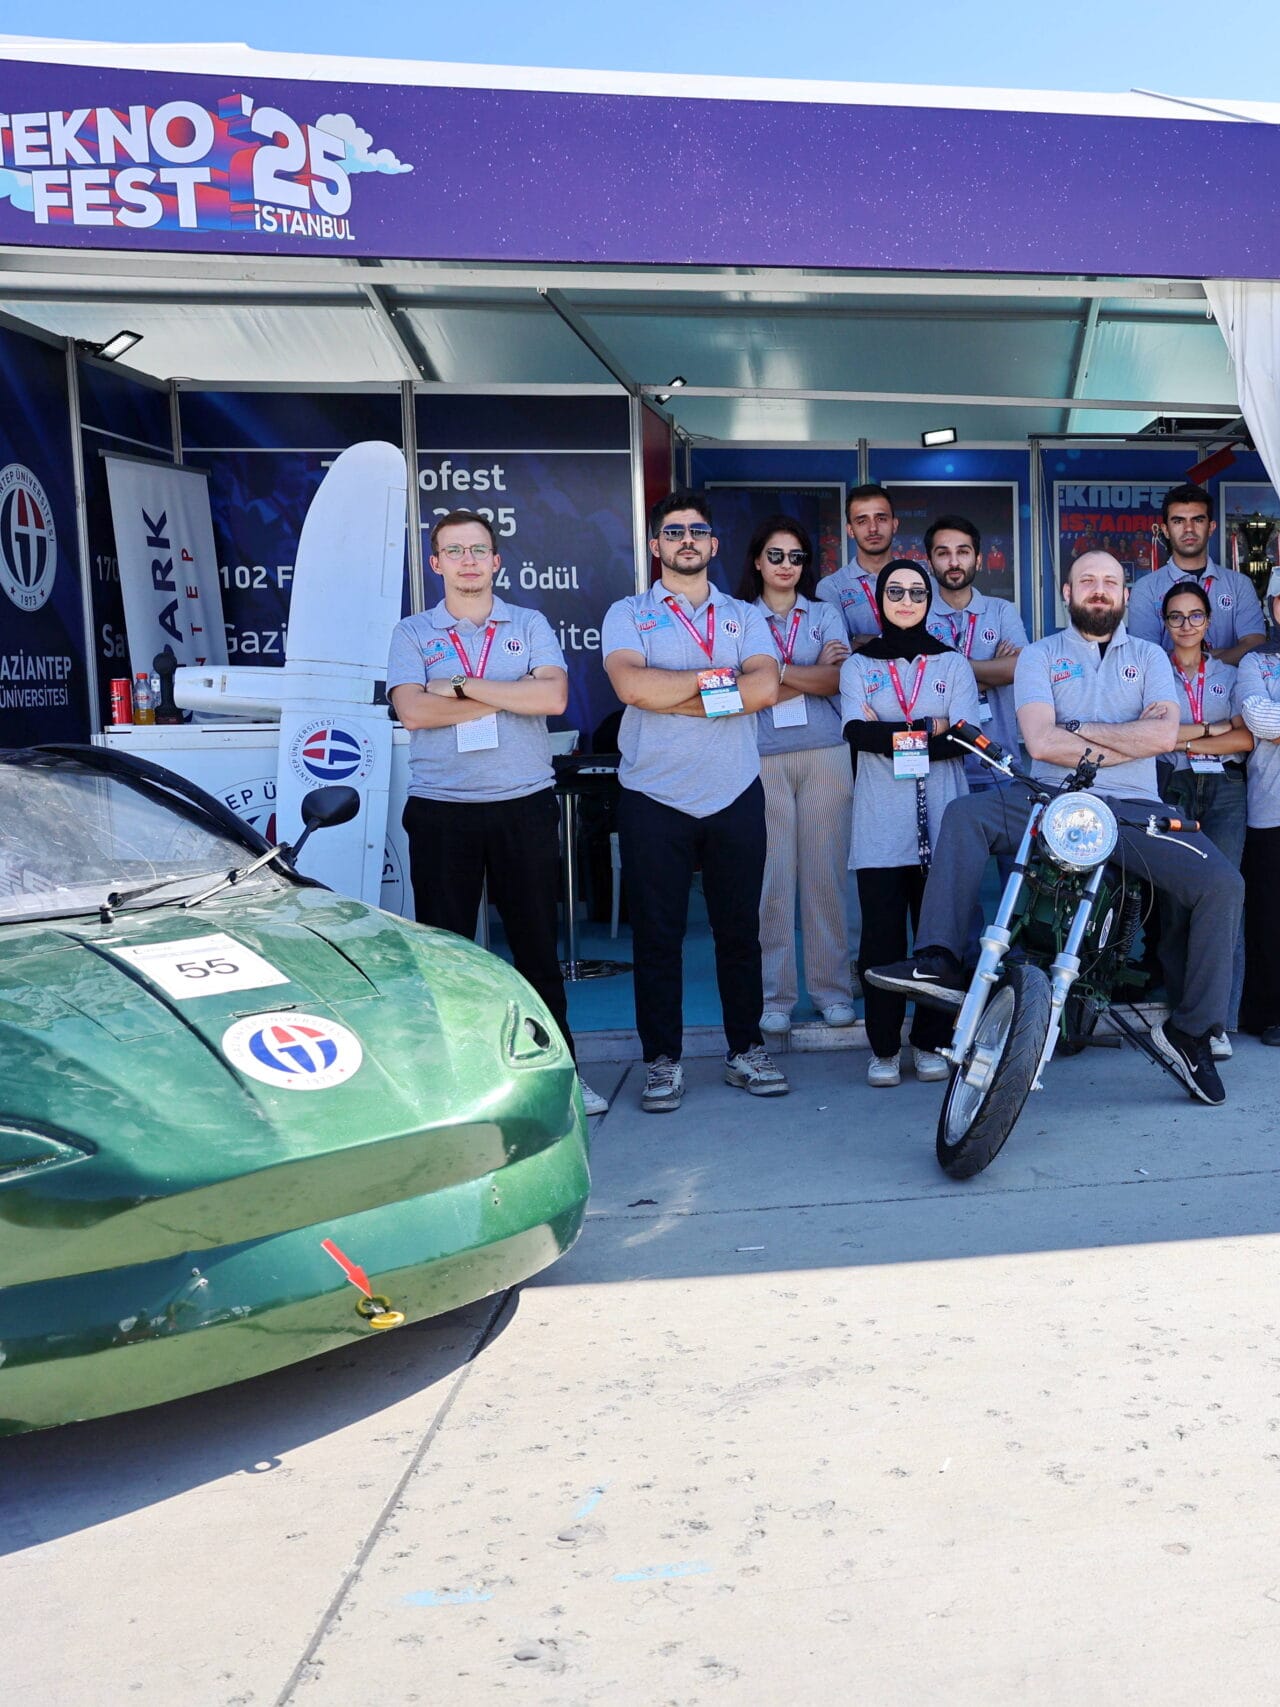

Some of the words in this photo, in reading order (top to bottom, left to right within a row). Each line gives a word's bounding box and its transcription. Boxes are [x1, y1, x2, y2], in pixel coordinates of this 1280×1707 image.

[0, 101, 214, 166] EKNO
[32, 167, 212, 229] FEST
[220, 566, 268, 589] 102
[520, 561, 579, 590] Ödül
[20, 595, 37, 606] 1973
[0, 649, 72, 681] AZİANTEP
[176, 957, 239, 979] 55
